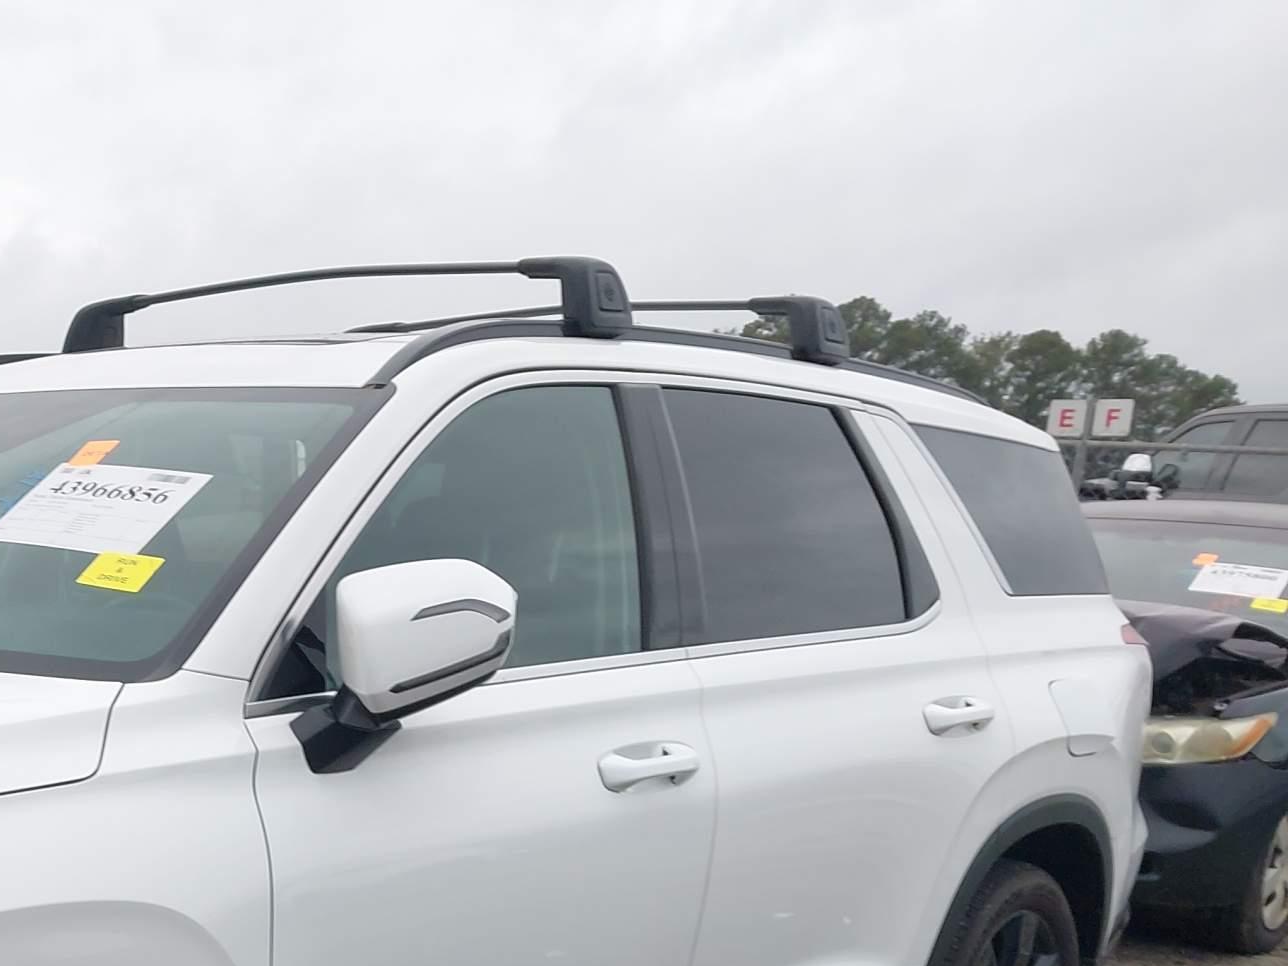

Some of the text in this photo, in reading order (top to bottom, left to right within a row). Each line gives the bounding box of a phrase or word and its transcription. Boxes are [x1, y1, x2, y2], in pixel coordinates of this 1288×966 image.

[1058, 408, 1076, 428] E
[1105, 408, 1123, 428] F
[49, 480, 176, 504] 43966856
[117, 557, 137, 566] RUN
[96, 573, 129, 584] DRIVE
